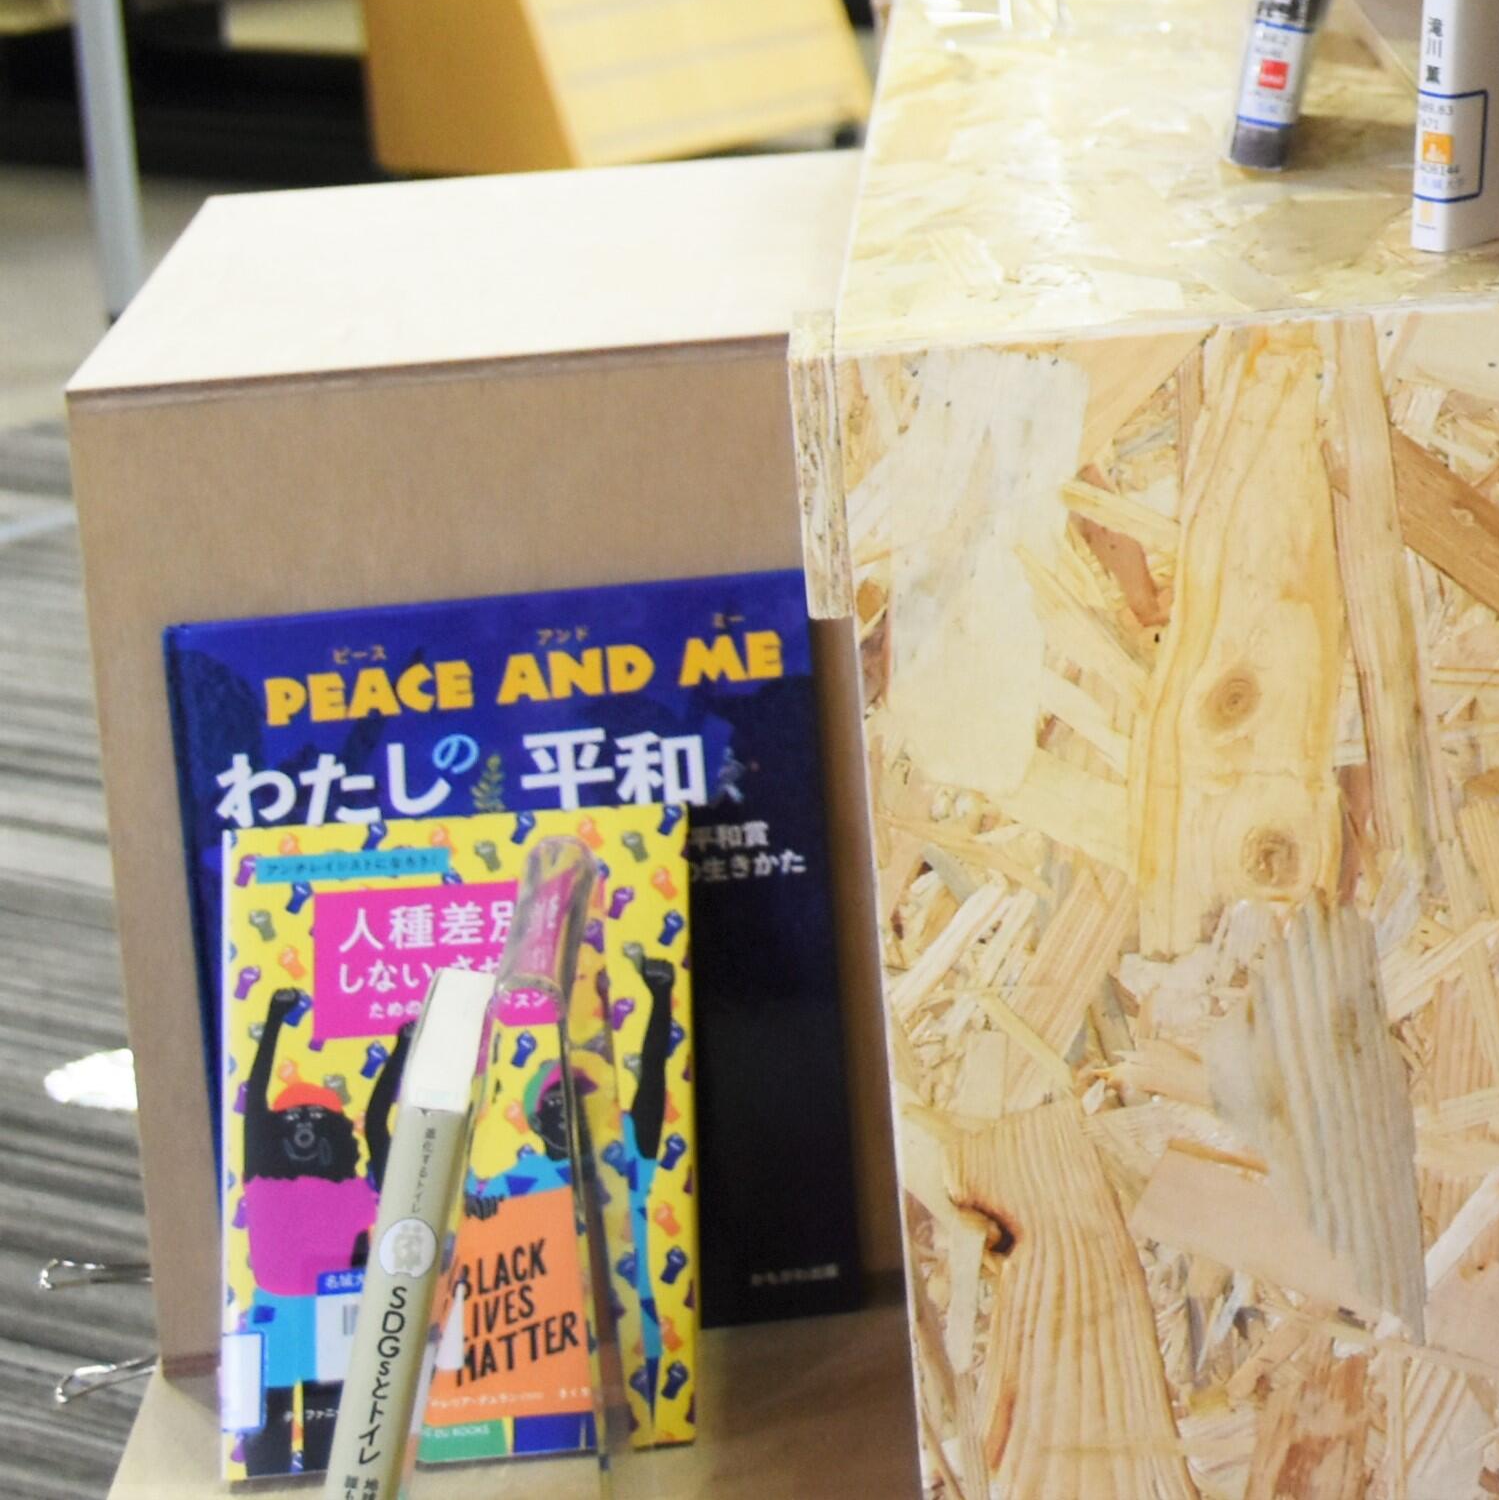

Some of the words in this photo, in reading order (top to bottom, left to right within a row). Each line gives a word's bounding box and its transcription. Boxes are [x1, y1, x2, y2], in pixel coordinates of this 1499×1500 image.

[263, 660, 474, 727] PEACE
[496, 645, 655, 706] AND
[678, 631, 784, 687] ME
[216, 727, 709, 828] わたしの平和
[358, 1285, 407, 1466] SDGsとトイレ
